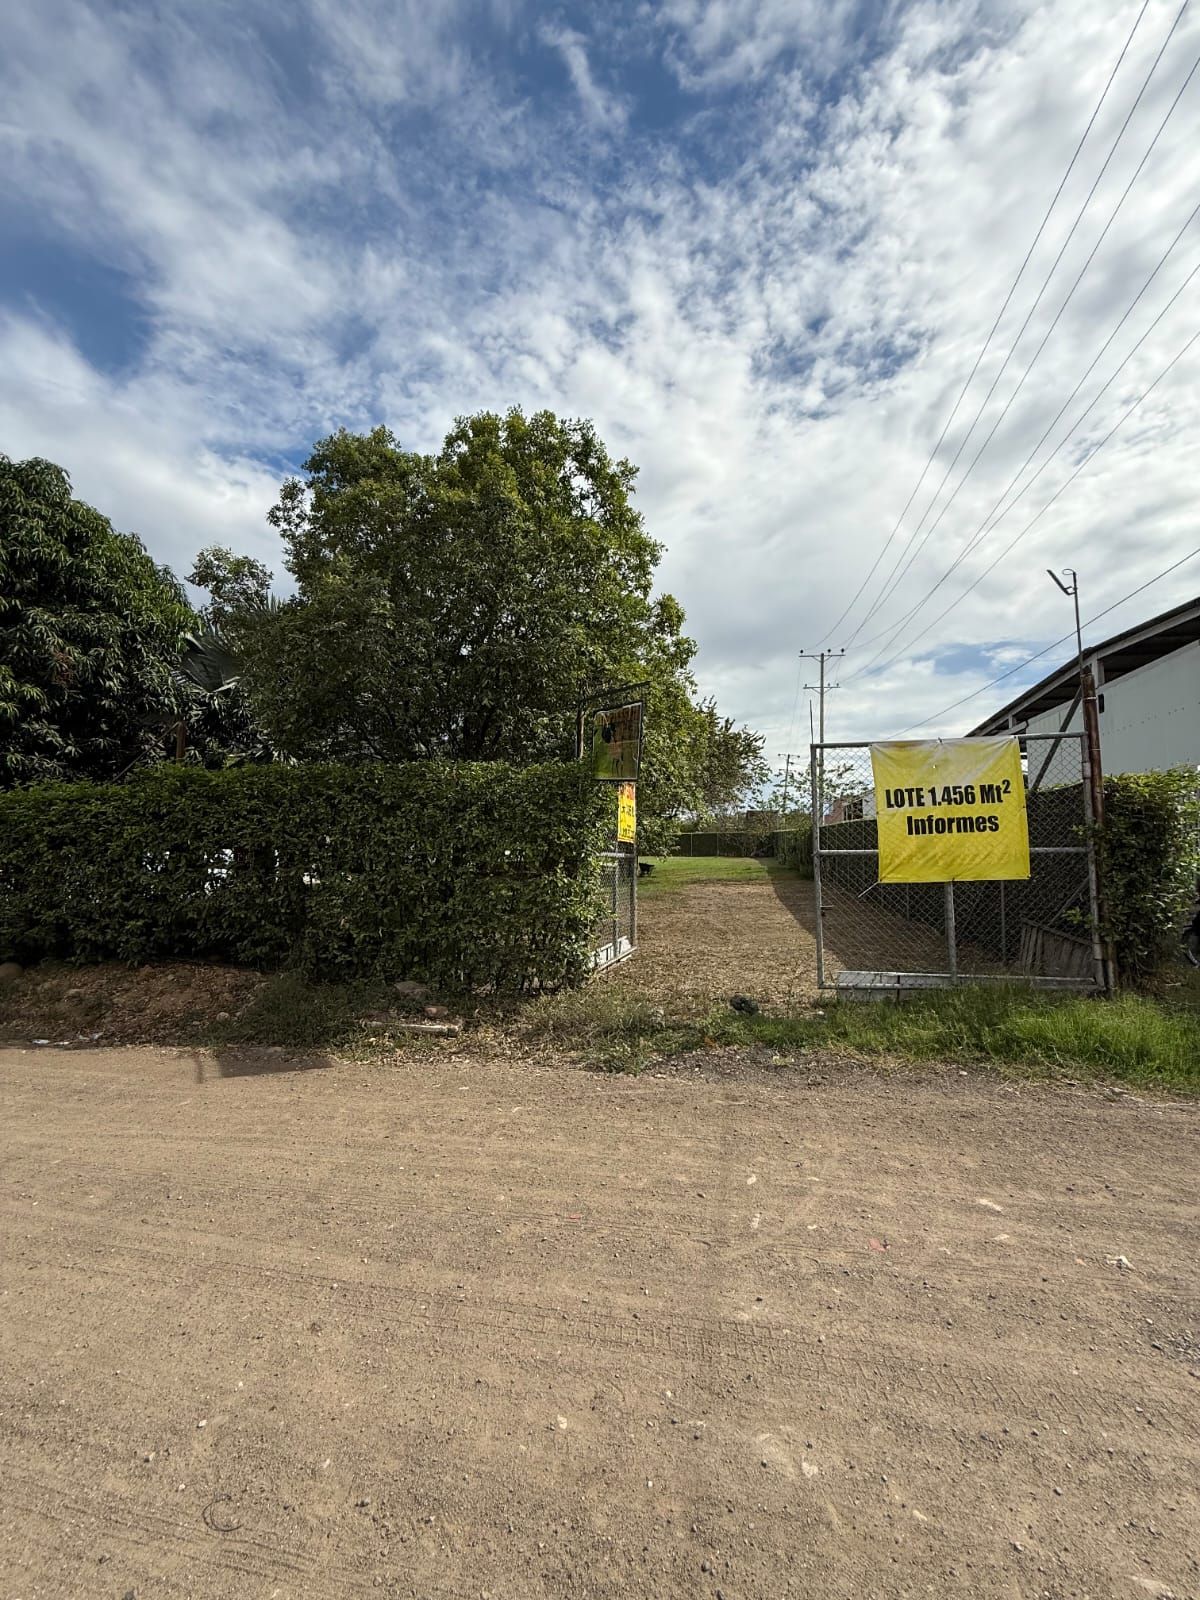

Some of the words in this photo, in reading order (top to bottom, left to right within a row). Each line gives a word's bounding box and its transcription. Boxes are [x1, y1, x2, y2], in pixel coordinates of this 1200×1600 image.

[885, 787, 925, 809] LOTE
[928, 784, 976, 807] 1.456
[906, 814, 1000, 836] Informes
